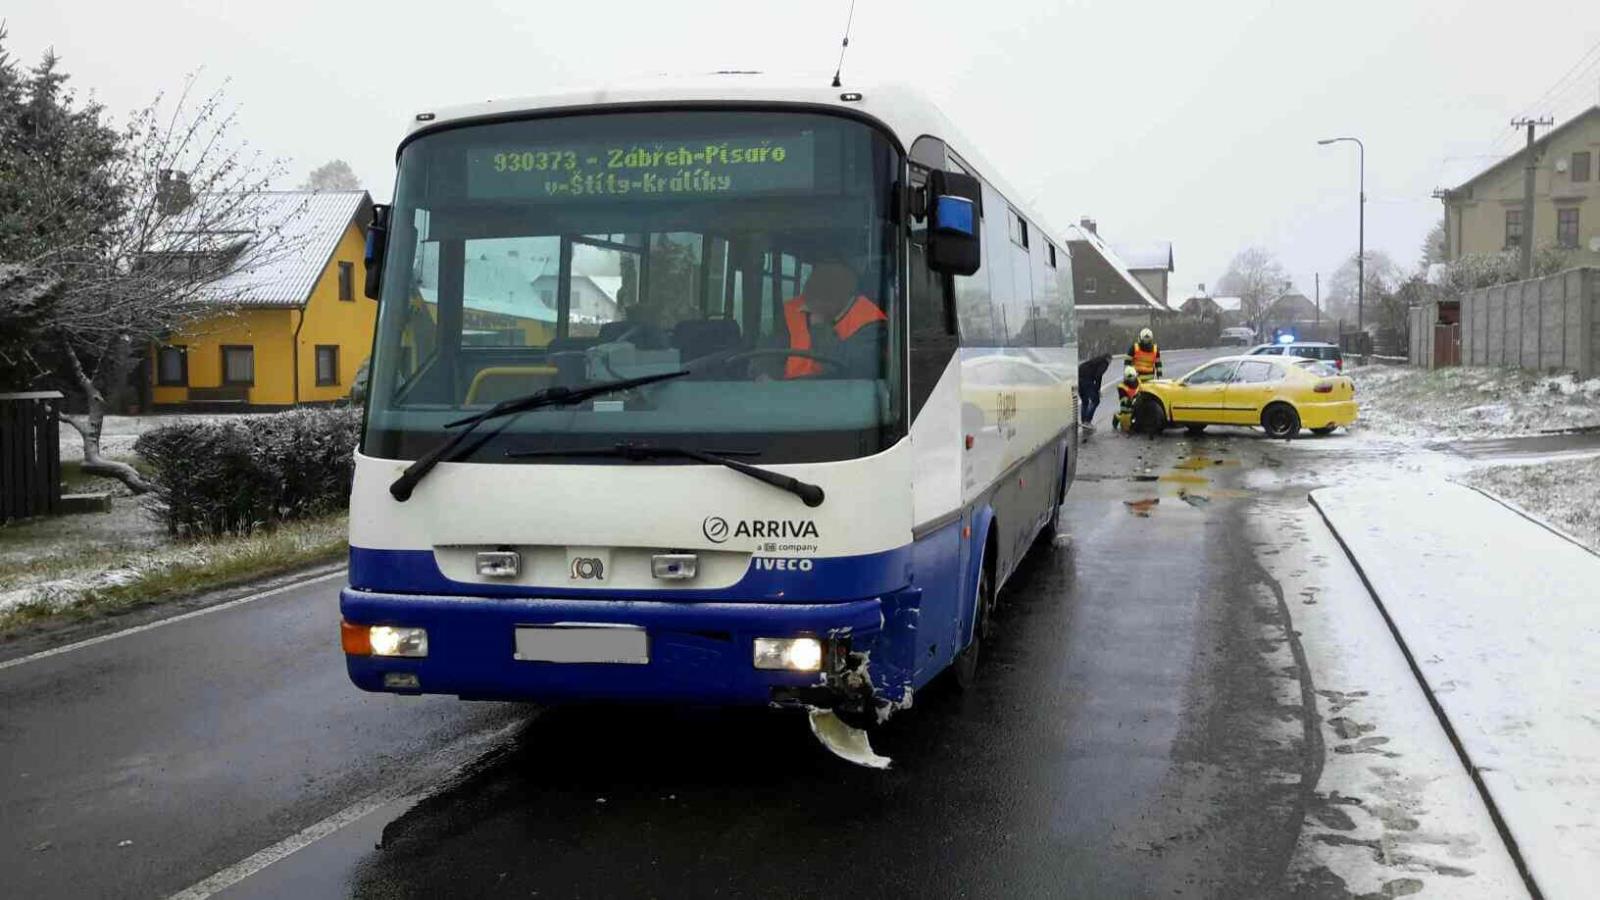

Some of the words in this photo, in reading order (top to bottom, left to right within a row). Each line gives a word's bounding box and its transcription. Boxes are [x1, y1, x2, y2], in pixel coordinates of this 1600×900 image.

[493, 152, 576, 172] 930373
[733, 520, 819, 538] ARRIVA
[778, 544, 818, 552] company
[755, 558, 813, 571] IVECO
